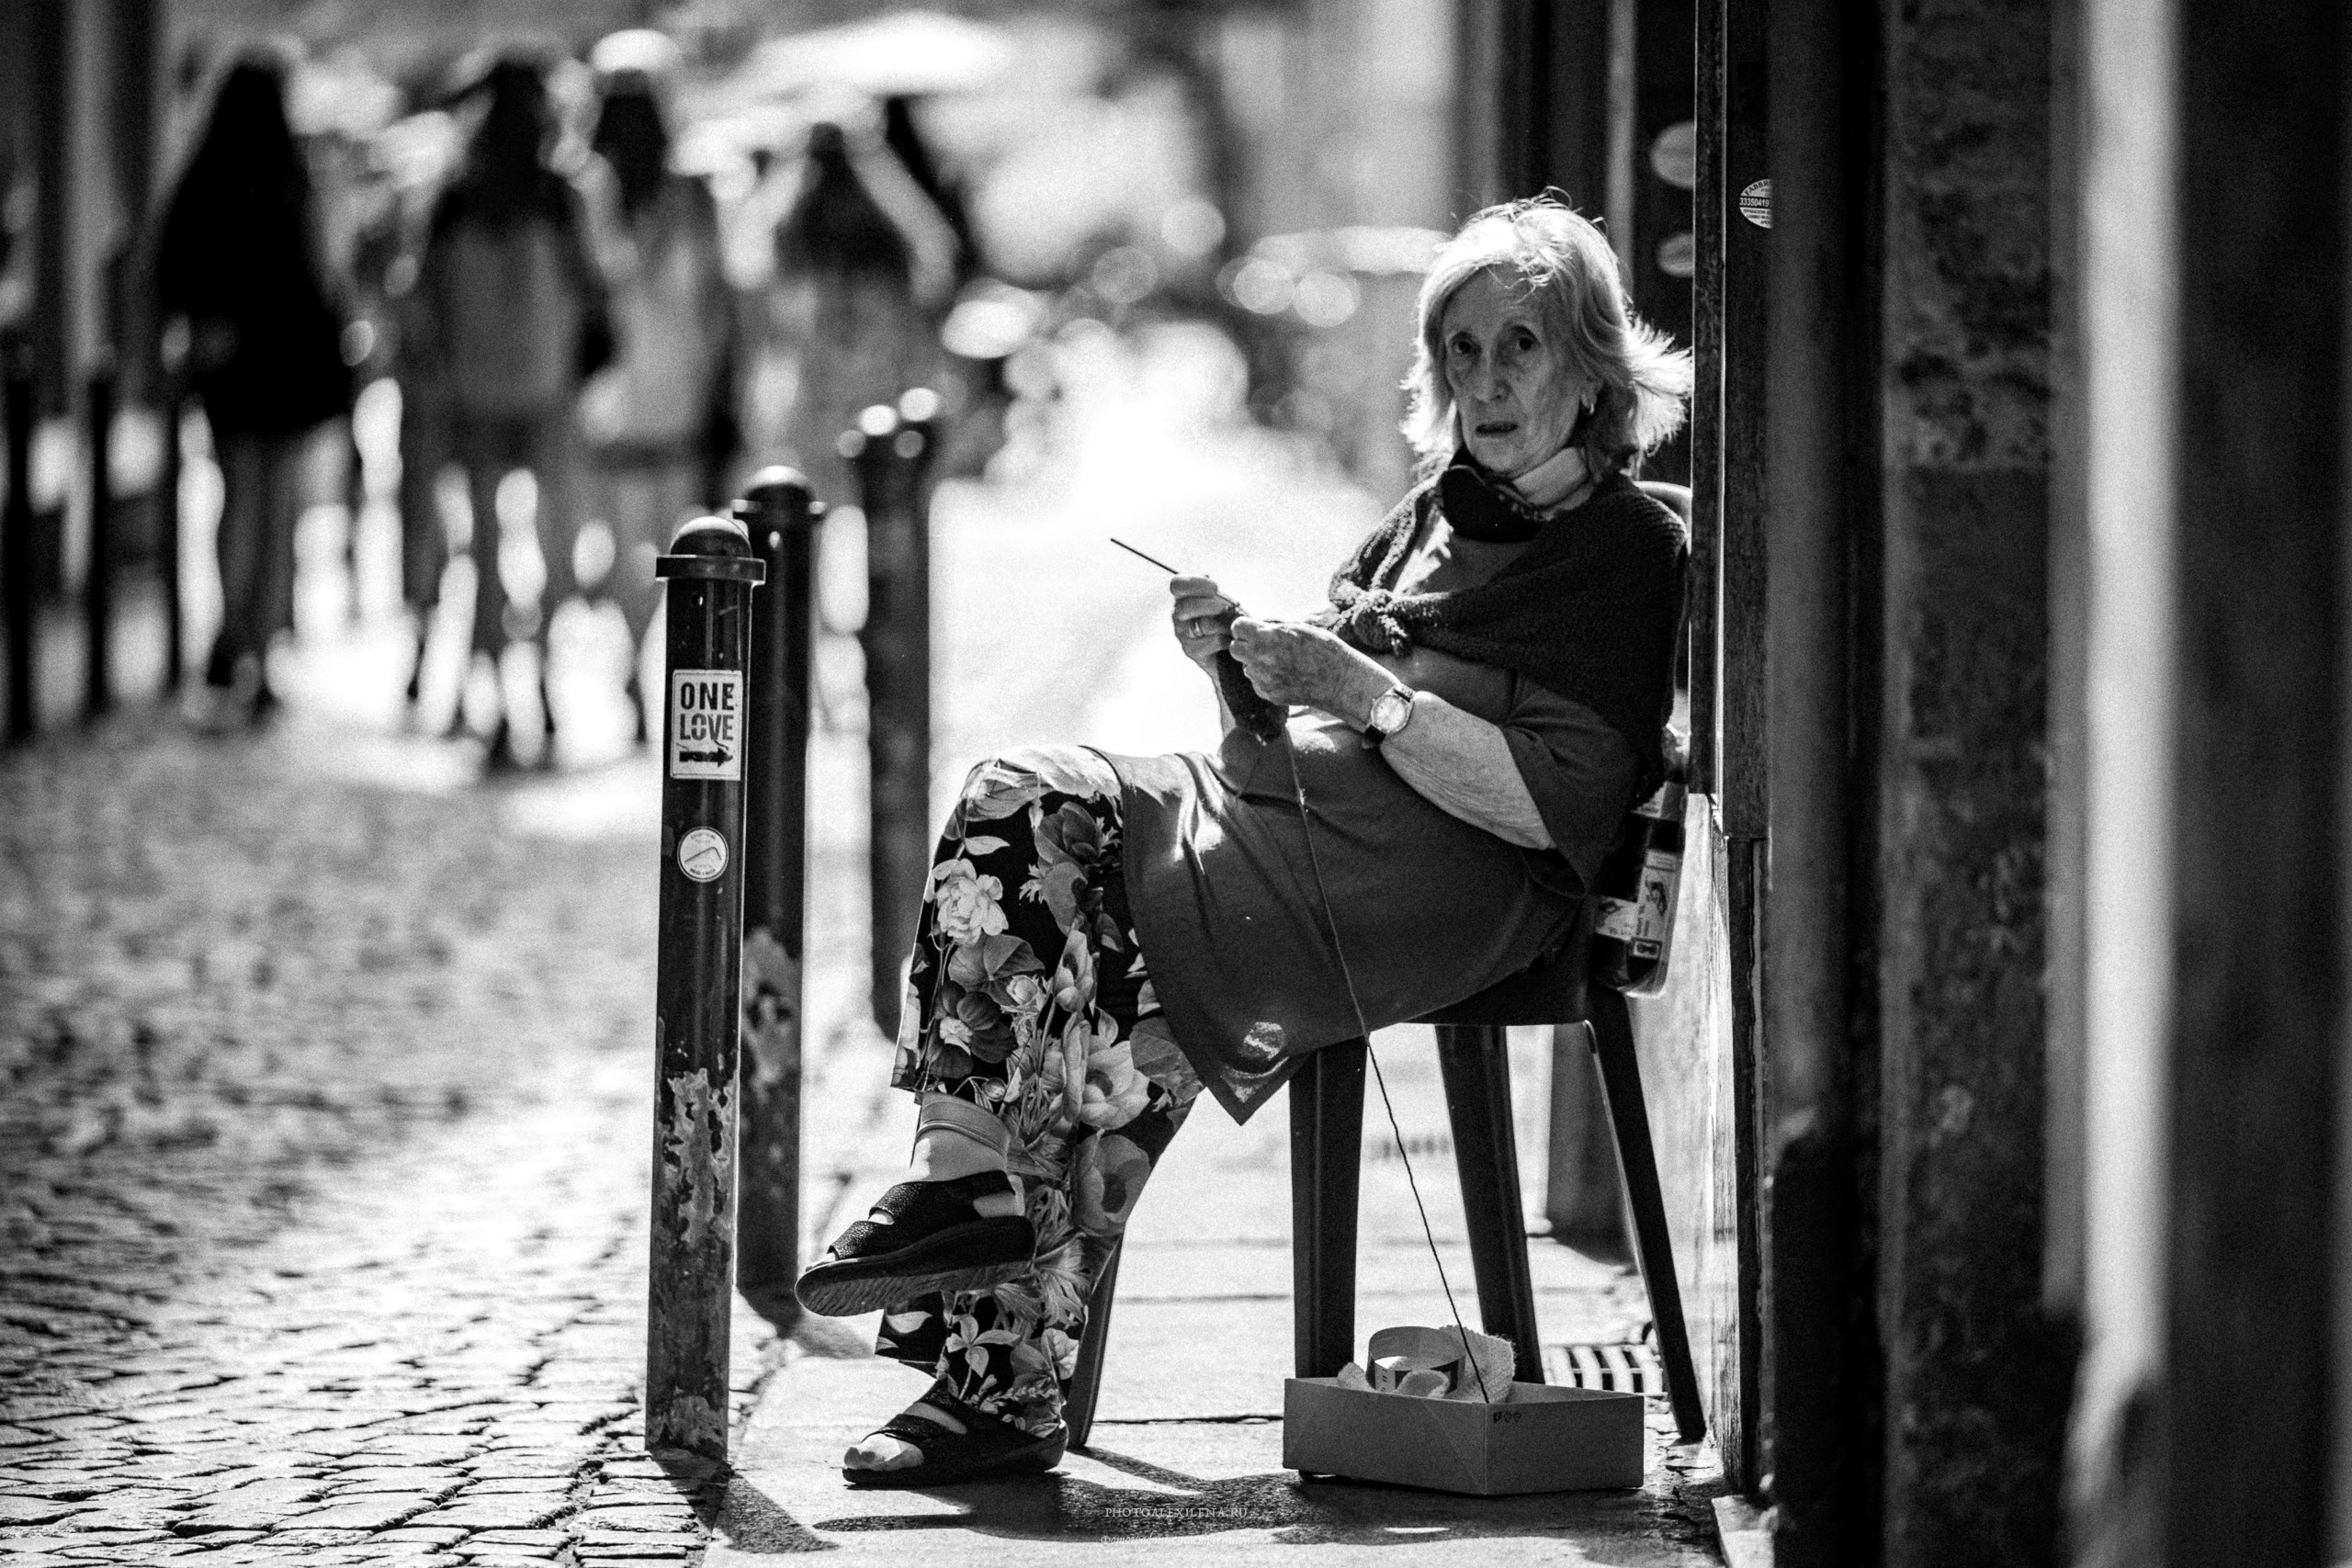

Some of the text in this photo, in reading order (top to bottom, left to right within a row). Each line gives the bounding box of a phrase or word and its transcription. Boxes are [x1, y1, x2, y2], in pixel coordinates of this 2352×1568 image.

[1744, 180, 1770, 196] FABBR
[1739, 197, 1770, 208] 33350419
[681, 682, 734, 711] ONE
[680, 713, 734, 740] LOVE
